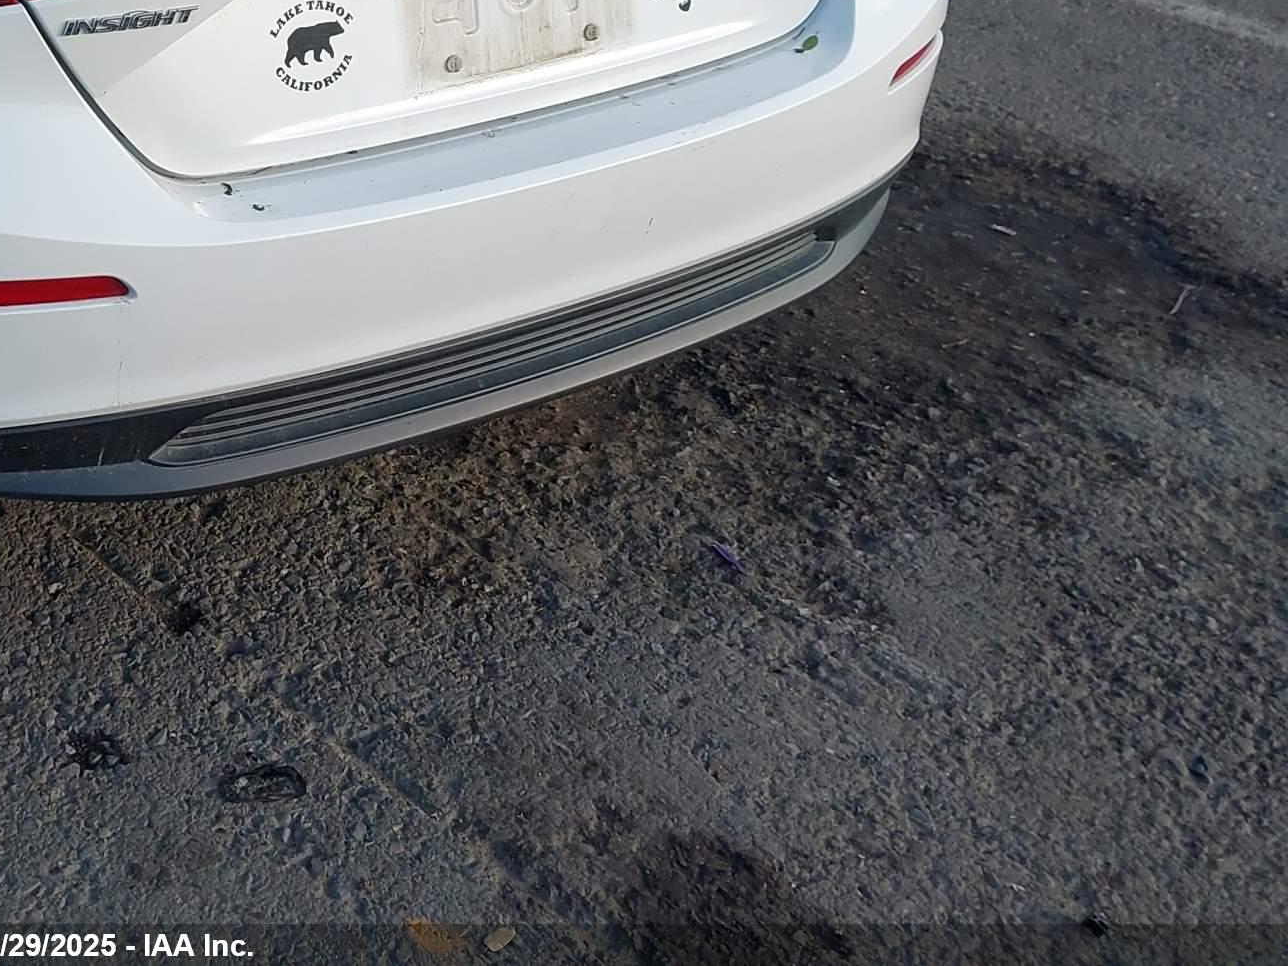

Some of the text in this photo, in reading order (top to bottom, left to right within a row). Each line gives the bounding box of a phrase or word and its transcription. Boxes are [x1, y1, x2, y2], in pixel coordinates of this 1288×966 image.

[62, 5, 199, 36] INSIGHT
[269, 0, 354, 38] LAKE TAHOE
[275, 54, 353, 92] CALIFORNIA
